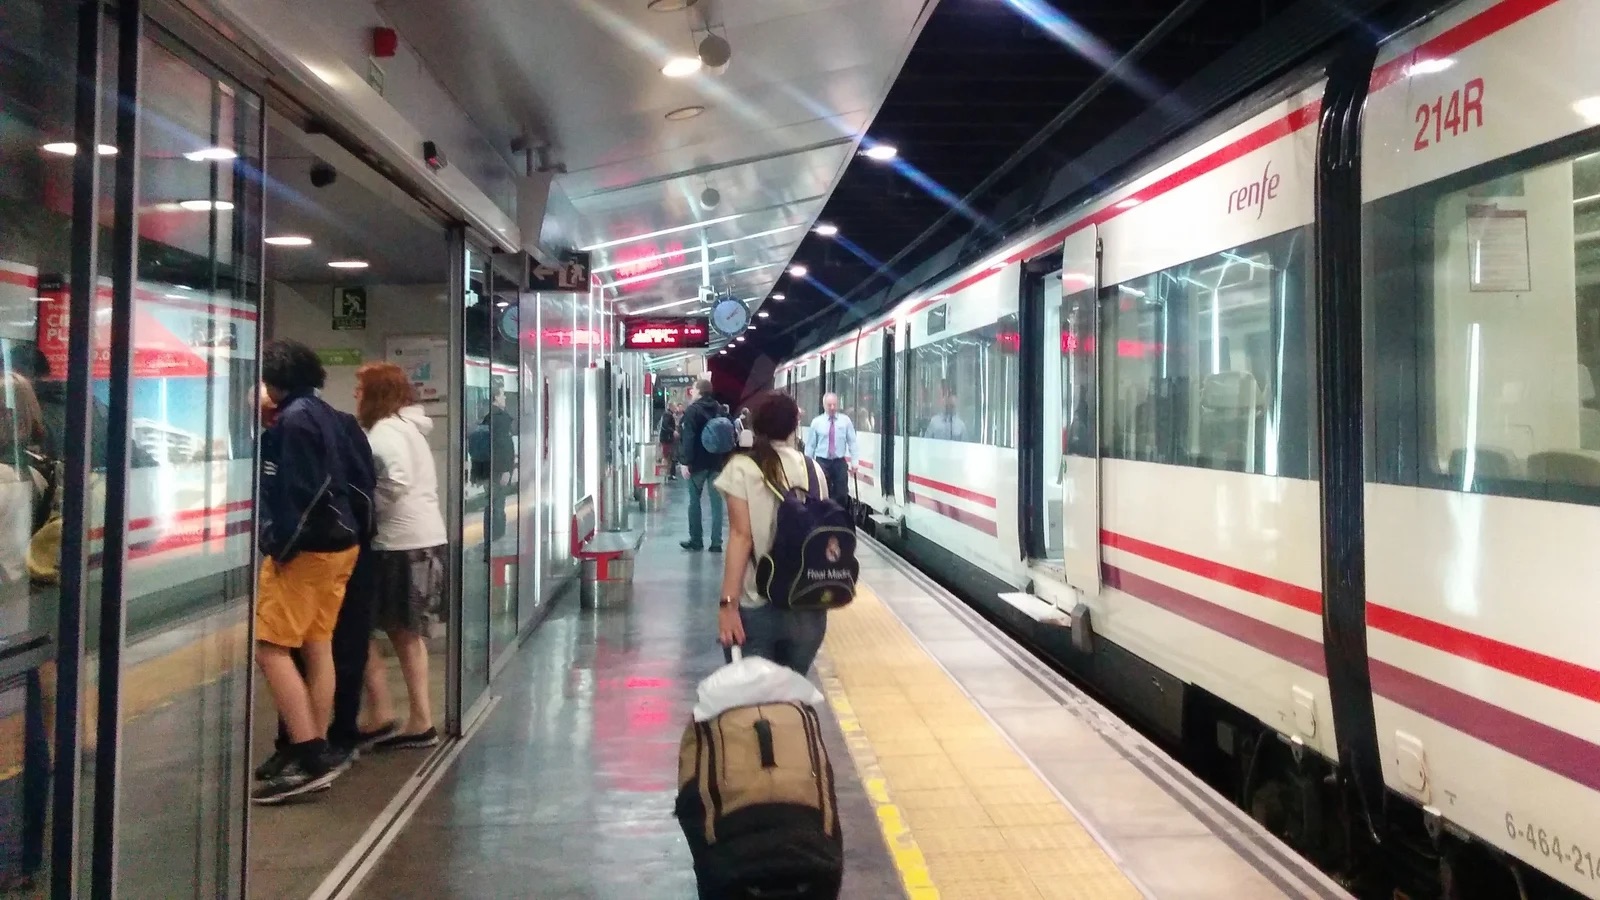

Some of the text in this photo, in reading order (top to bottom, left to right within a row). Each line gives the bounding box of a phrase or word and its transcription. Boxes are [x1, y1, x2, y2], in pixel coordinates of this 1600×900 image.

[1414, 77, 1484, 151] 214R
[1228, 160, 1280, 220] renfe
[807, 569, 851, 580] Real Madri
